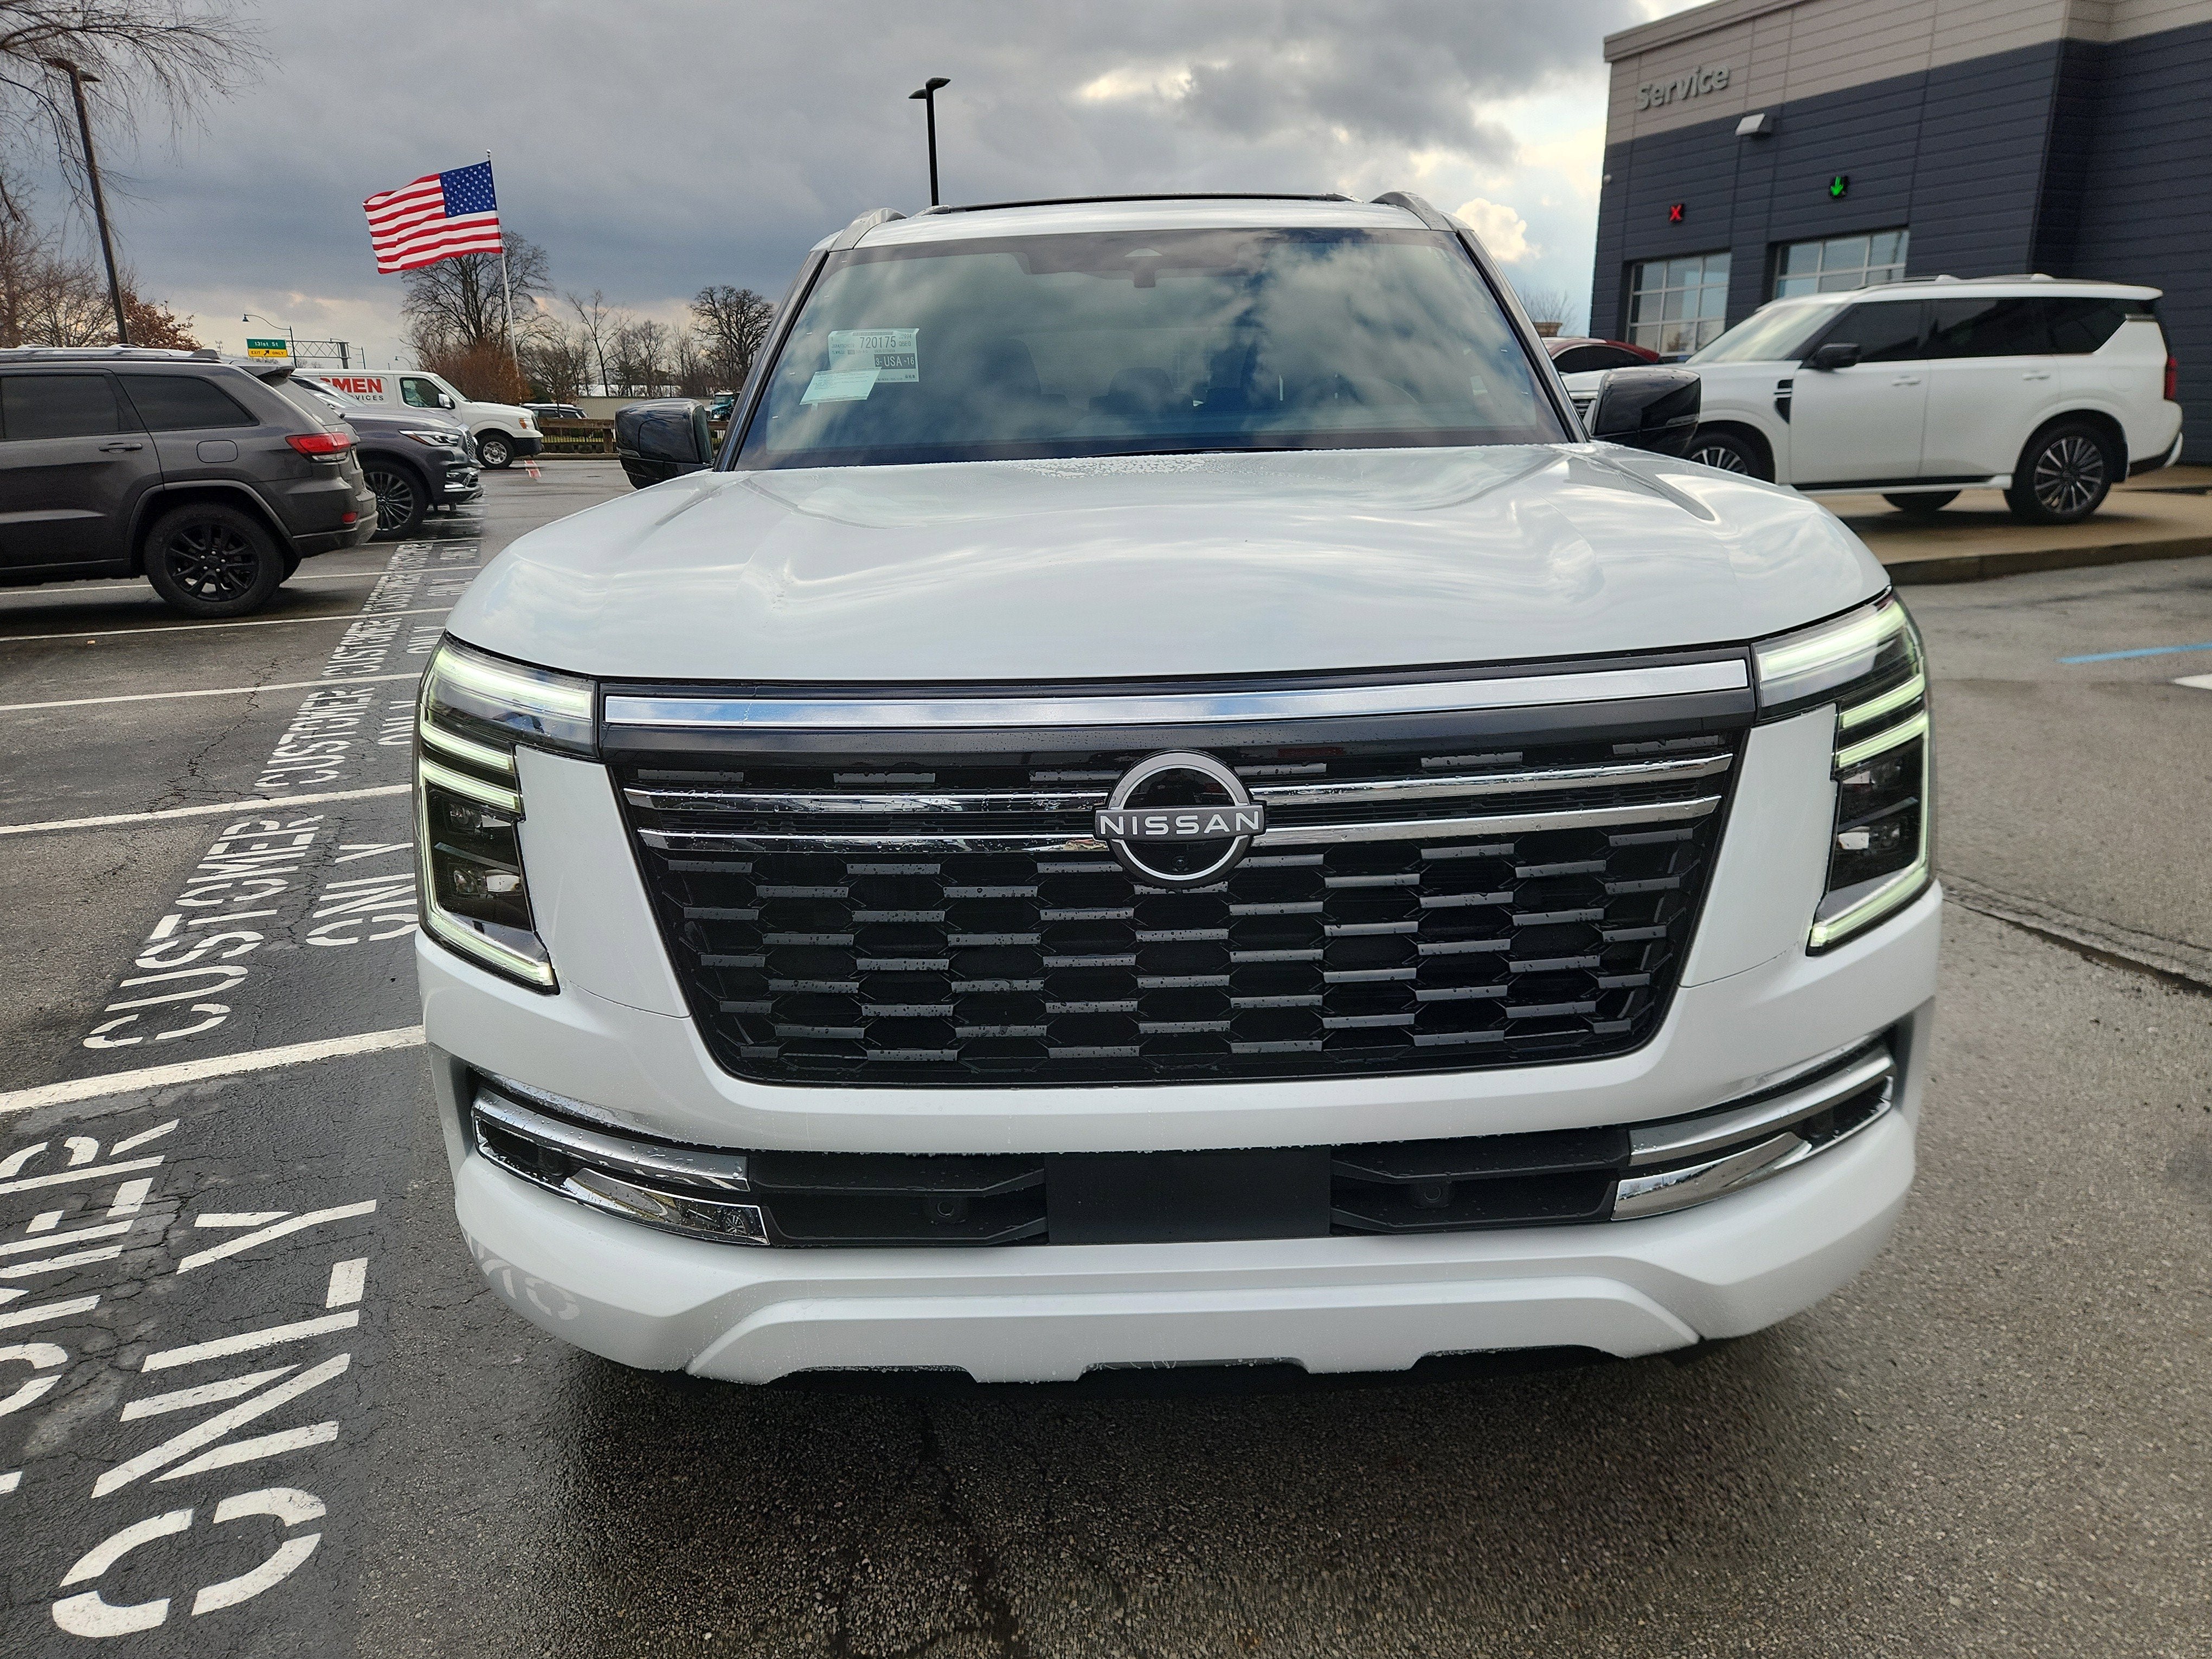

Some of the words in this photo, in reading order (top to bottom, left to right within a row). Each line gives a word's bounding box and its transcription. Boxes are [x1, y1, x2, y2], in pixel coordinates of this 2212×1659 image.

[1636, 65, 1729, 111] Service
[860, 336, 896, 349] 720175
[884, 356, 902, 366] USA
[320, 377, 382, 393] MEN
[362, 573, 422, 612] CUSTOMER
[321, 618, 402, 677] CUSTOMER
[254, 687, 375, 787] CUSTOMER
[1100, 811, 1259, 835] NISSAN
[306, 843, 419, 946] ONLY
[83, 815, 324, 1049] CUSTOMER
[52, 1199, 377, 1638] ONLY
